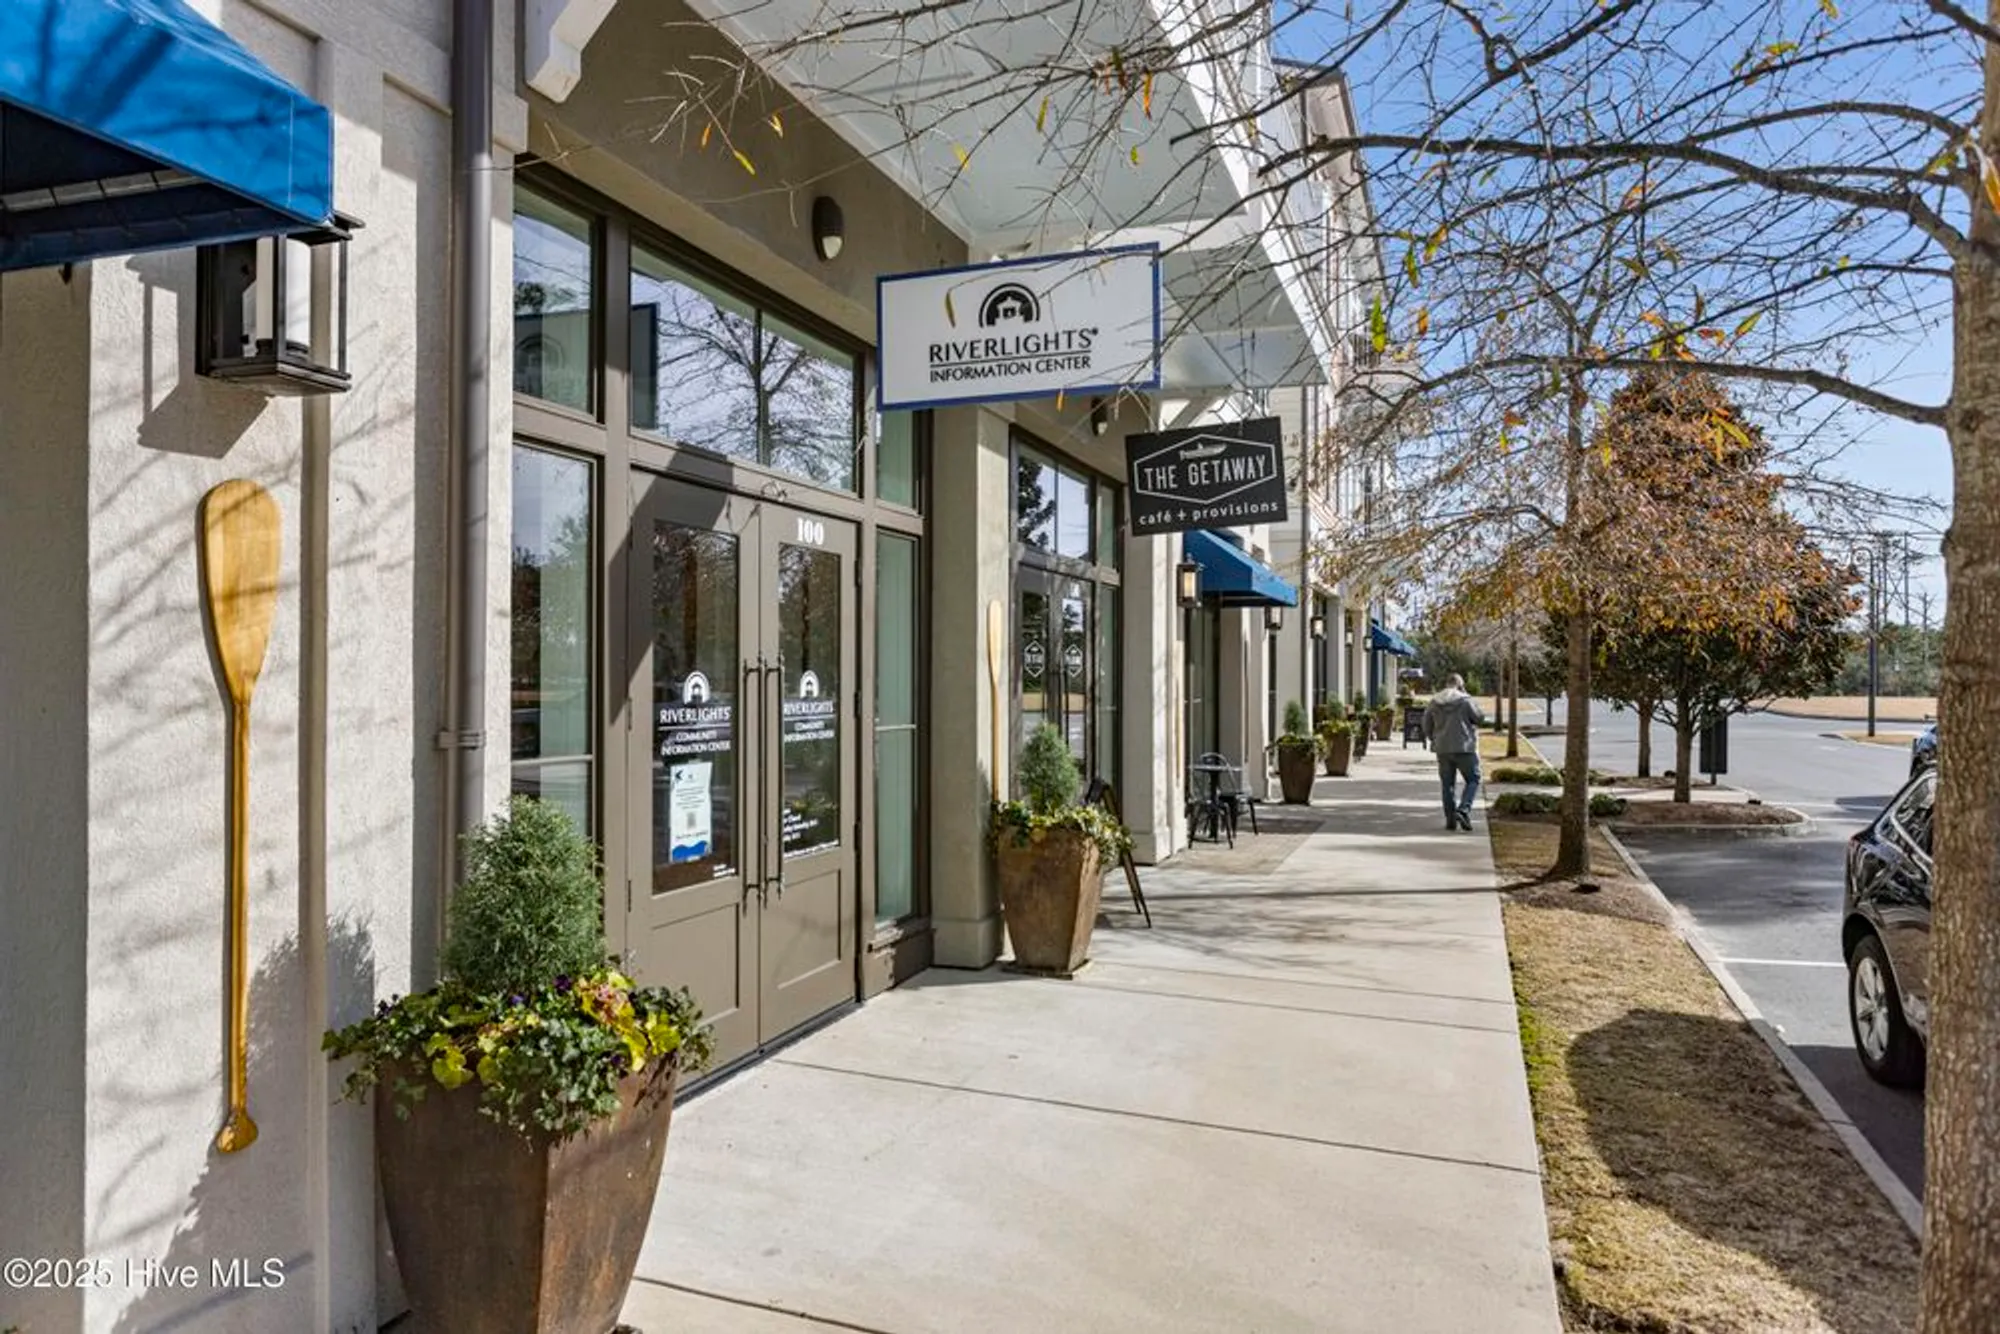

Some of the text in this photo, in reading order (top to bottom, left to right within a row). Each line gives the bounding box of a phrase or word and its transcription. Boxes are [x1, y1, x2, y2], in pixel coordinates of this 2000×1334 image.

[929, 356, 1091, 383] INFORMATION CENTER
[1144, 454, 1266, 491] THE GETAWAY
[1139, 511, 1171, 525] café
[1191, 502, 1278, 521] provisions
[796, 517, 825, 546] 100
[659, 706, 731, 724] RIVERLIGHTS
[783, 700, 834, 715] RIVERLIGHTS
[675, 730, 718, 742] COMMUNITY
[661, 740, 731, 756] INFORMATION CENTER
